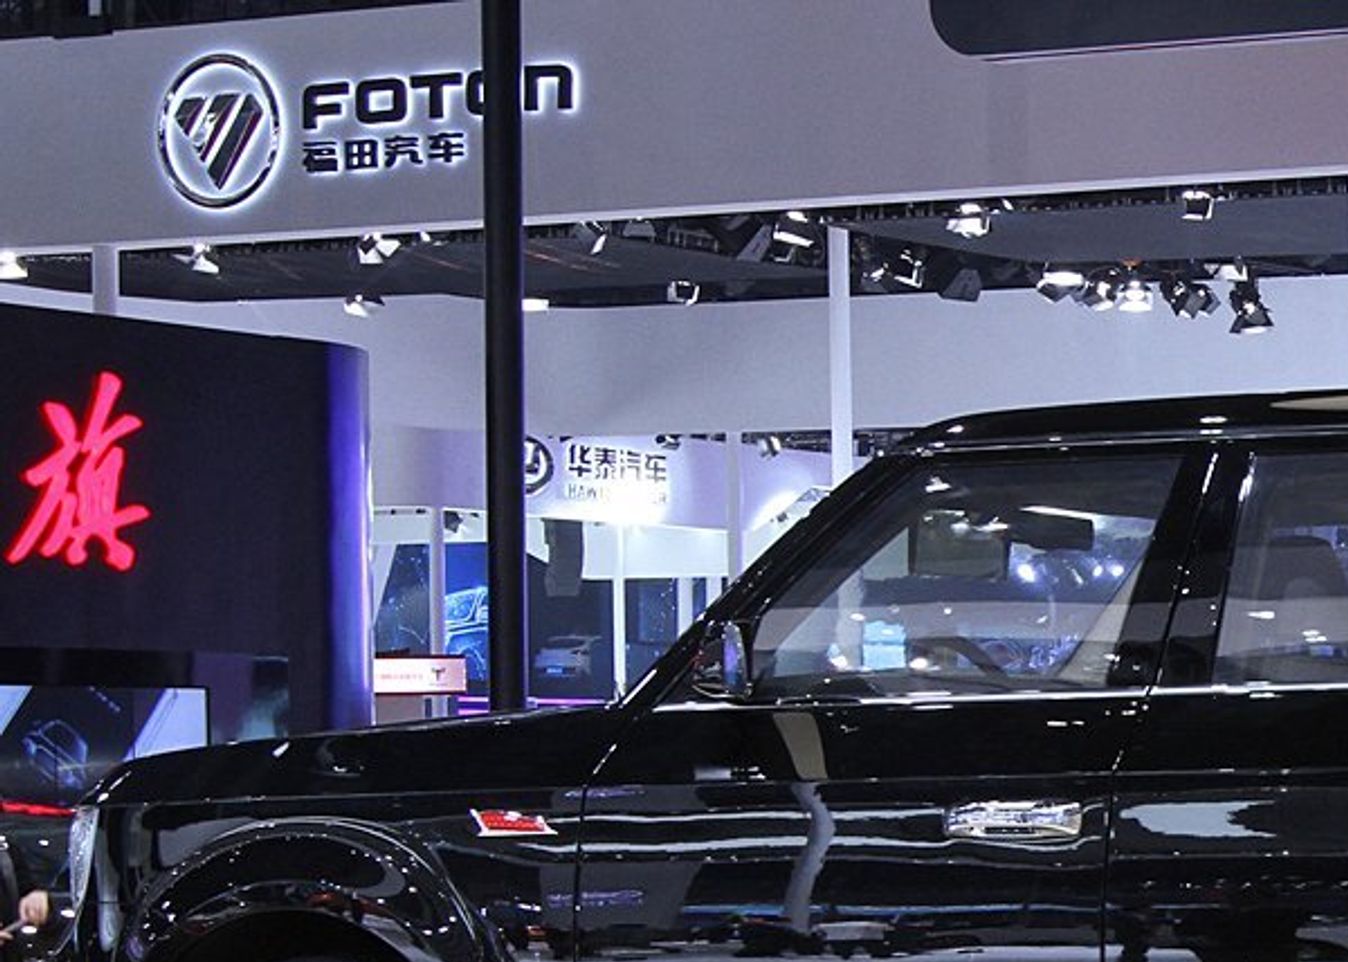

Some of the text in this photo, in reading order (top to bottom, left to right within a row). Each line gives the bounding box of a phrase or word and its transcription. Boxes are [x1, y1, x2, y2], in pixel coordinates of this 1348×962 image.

[5, 370, 151, 571] 旗
[568, 444, 666, 482] 华泰汽车
